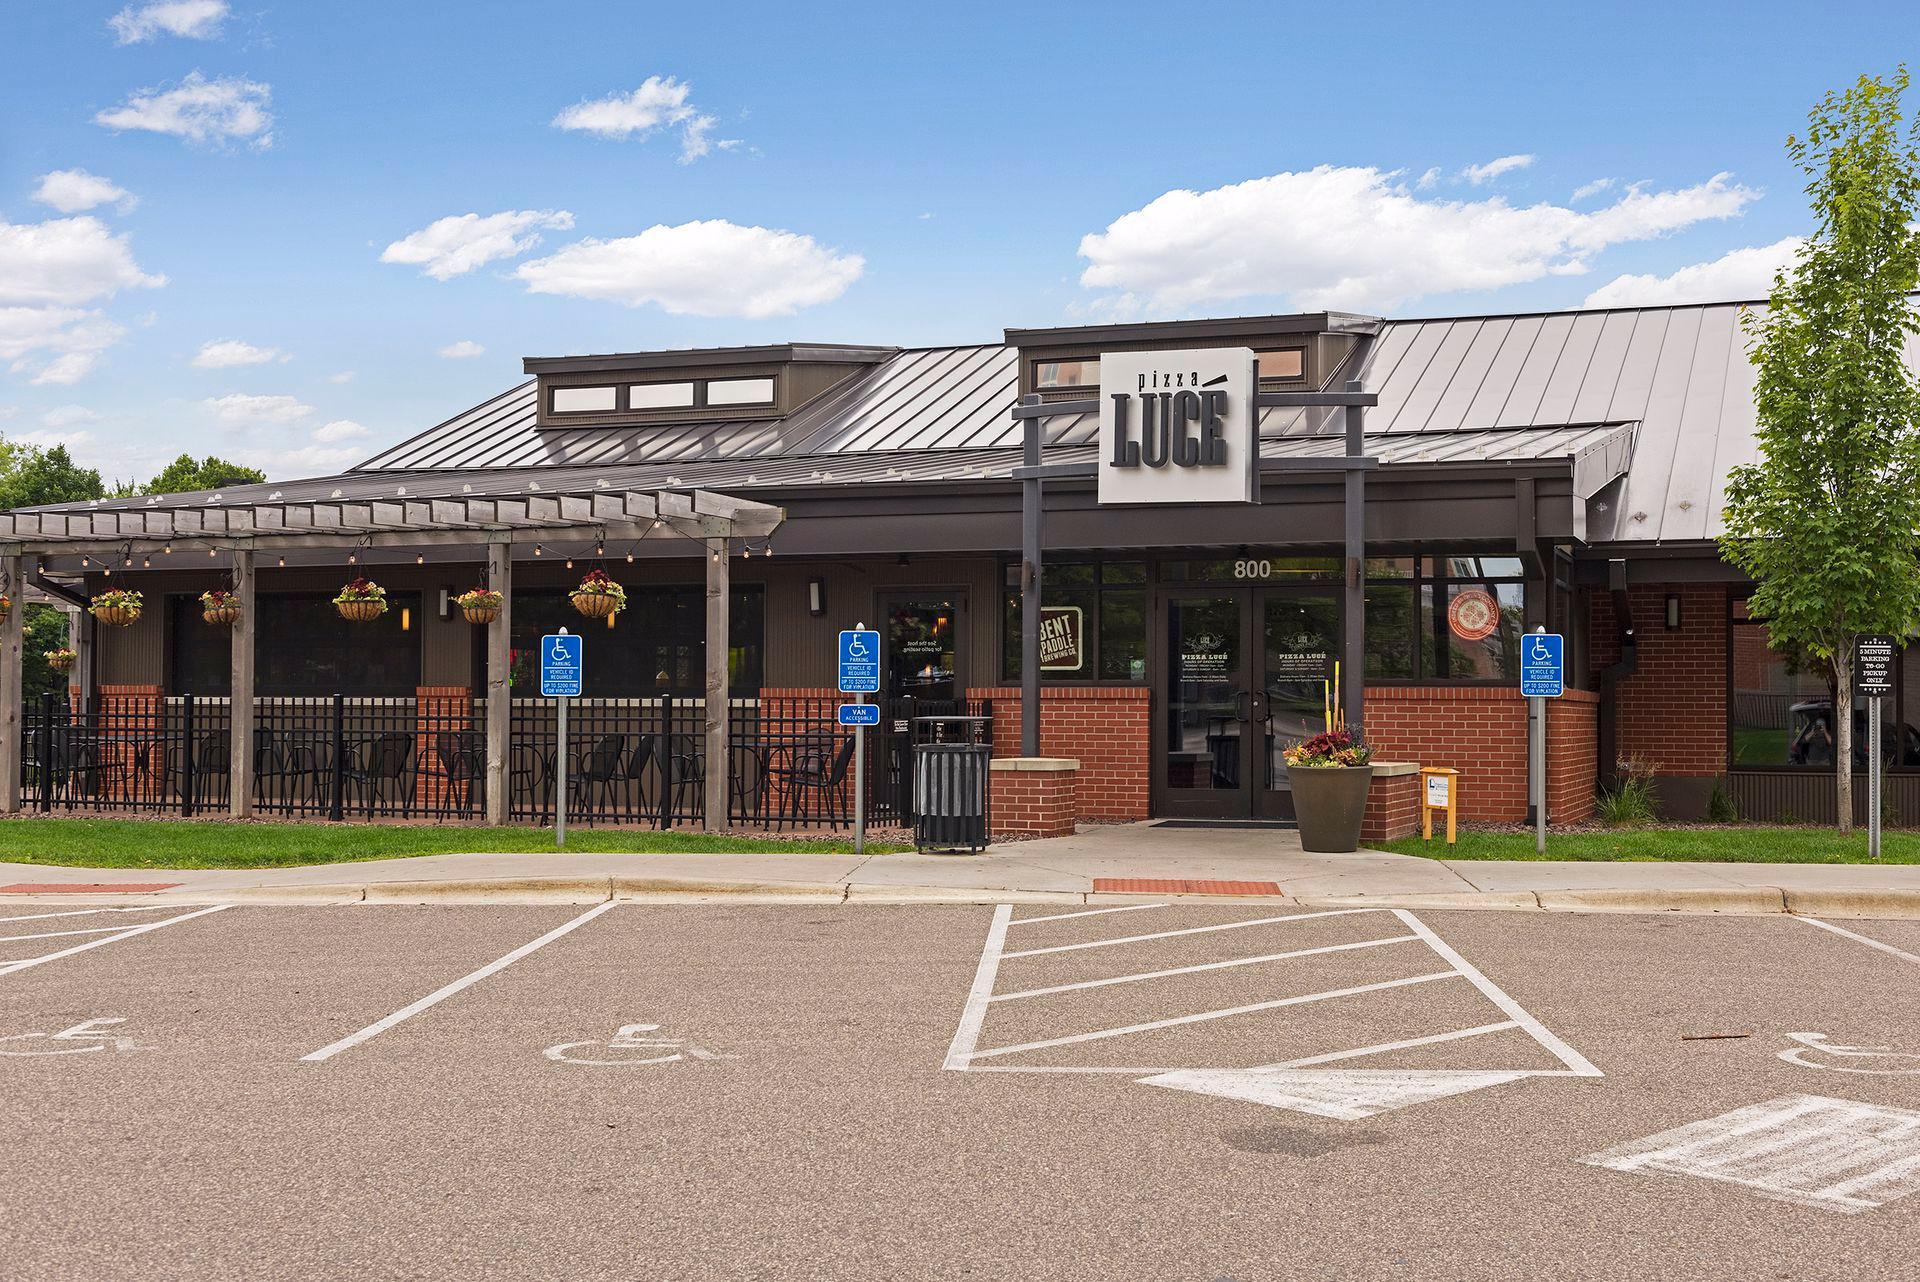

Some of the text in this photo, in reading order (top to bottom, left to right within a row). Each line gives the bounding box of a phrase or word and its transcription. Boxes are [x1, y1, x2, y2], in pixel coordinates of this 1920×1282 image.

[1138, 370, 1198, 392] pizza
[1110, 374, 1228, 468] LUCÉ
[1234, 560, 1271, 578] 800
[1040, 614, 1071, 642] BENT
[1040, 634, 1074, 655] PADDLE
[1043, 649, 1068, 663] BREWING
[1208, 652, 1228, 660] LUCÉ
[1306, 651, 1327, 660] LUCÉ
